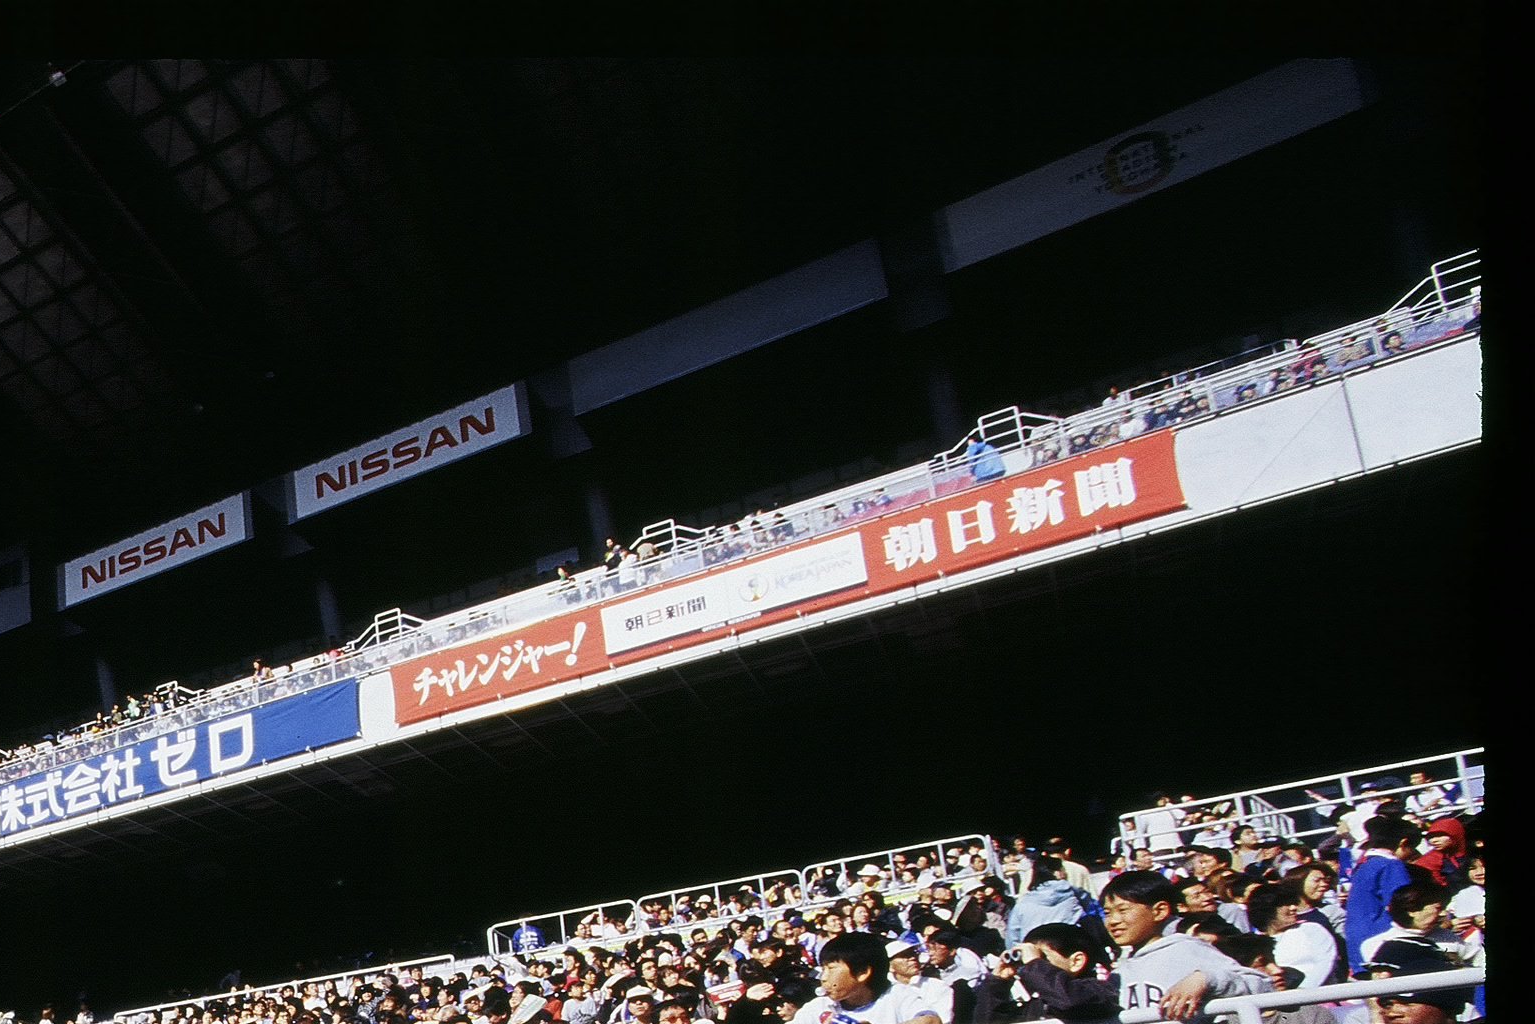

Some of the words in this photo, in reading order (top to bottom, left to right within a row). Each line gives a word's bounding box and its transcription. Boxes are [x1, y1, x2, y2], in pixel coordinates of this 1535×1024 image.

[315, 406, 496, 500] NISSAN
[81, 512, 226, 589] NISSAN
[883, 456, 1137, 572] 朝日新聞
